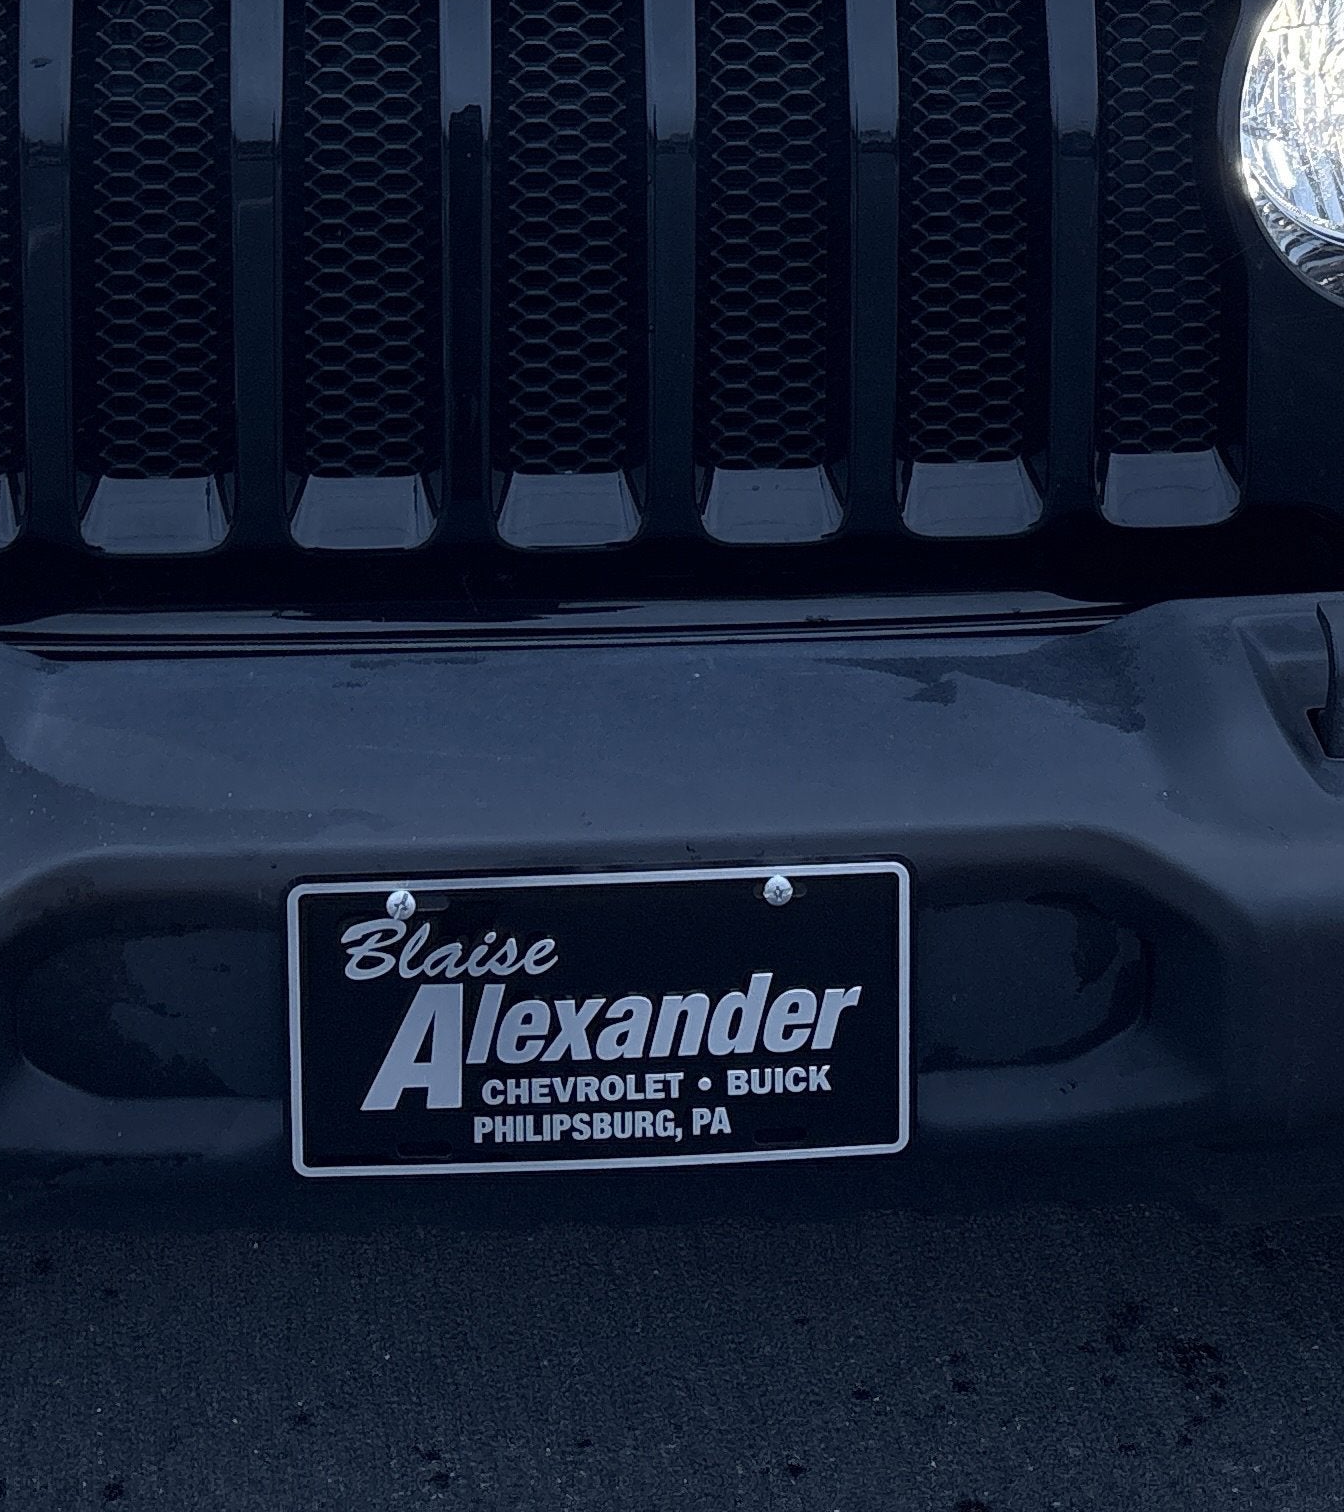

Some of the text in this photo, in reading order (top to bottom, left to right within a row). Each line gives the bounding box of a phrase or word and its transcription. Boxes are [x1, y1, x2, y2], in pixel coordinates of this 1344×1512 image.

[340, 918, 559, 982] Blaise
[360, 972, 863, 1111] Alexander
[481, 1065, 832, 1107] CHEVROLET BUICK
[473, 1107, 732, 1144] PHILIPSBURG, PA
